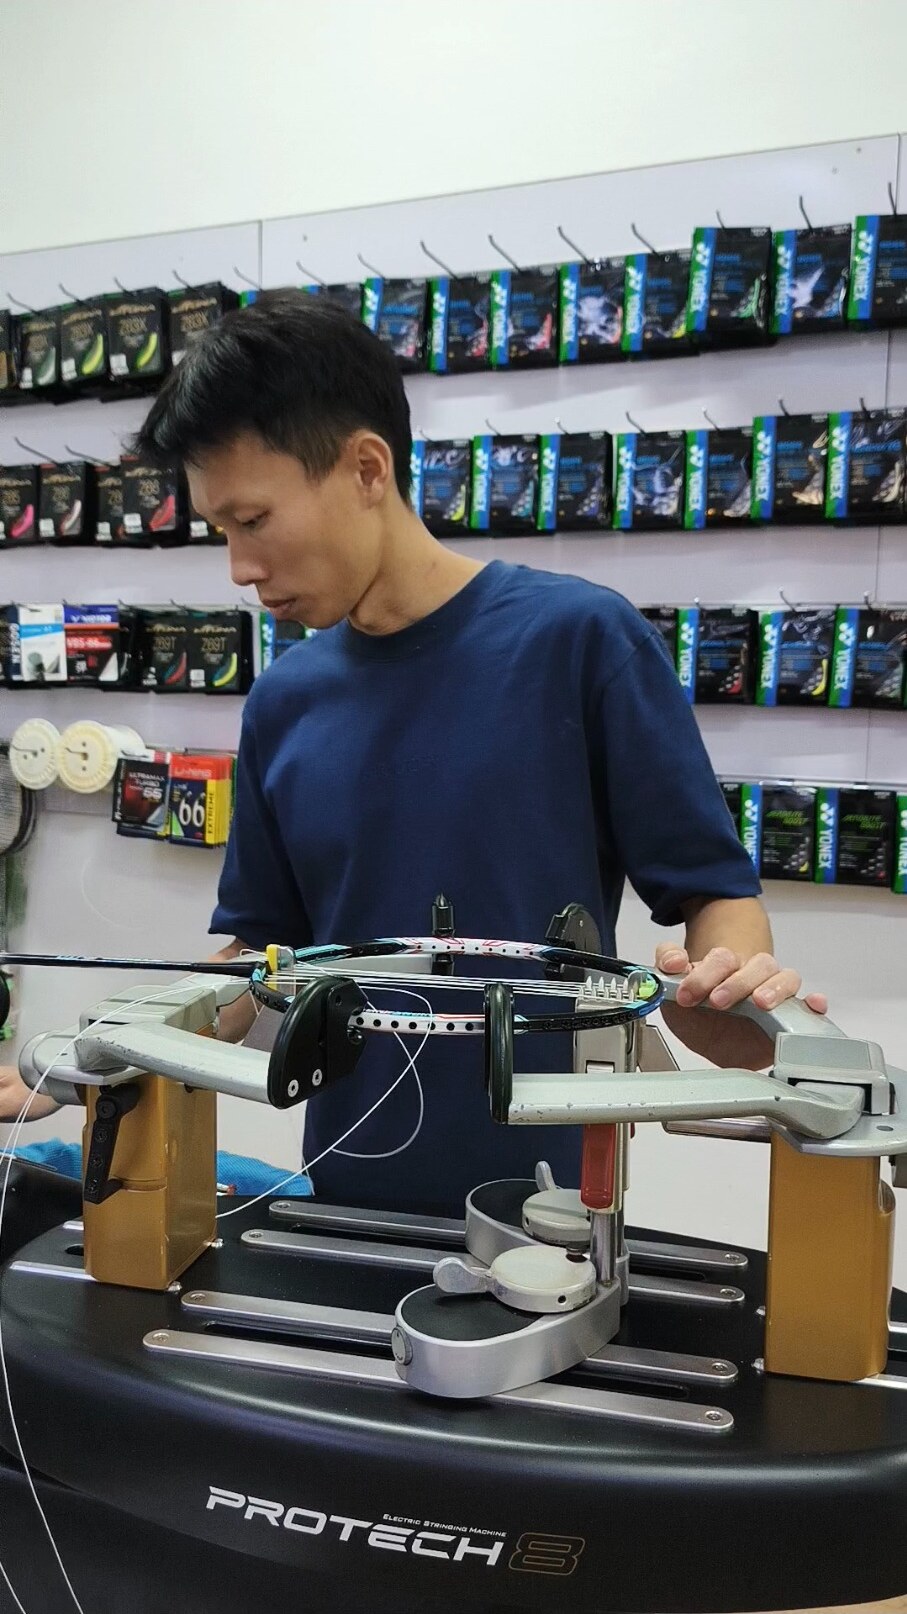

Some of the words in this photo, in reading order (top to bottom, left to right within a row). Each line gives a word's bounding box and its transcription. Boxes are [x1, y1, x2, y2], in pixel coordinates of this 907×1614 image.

[853, 257, 870, 300] YONEX
[689, 471, 703, 511] YONEX
[755, 457, 771, 500] YONEX
[830, 455, 845, 499] YONEX
[680, 648, 692, 687] YONEX
[834, 648, 850, 689] YONEX
[819, 829, 834, 868] YONEX
[205, 1485, 504, 1567] PROTECH
[508, 1532, 585, 1576] 8
